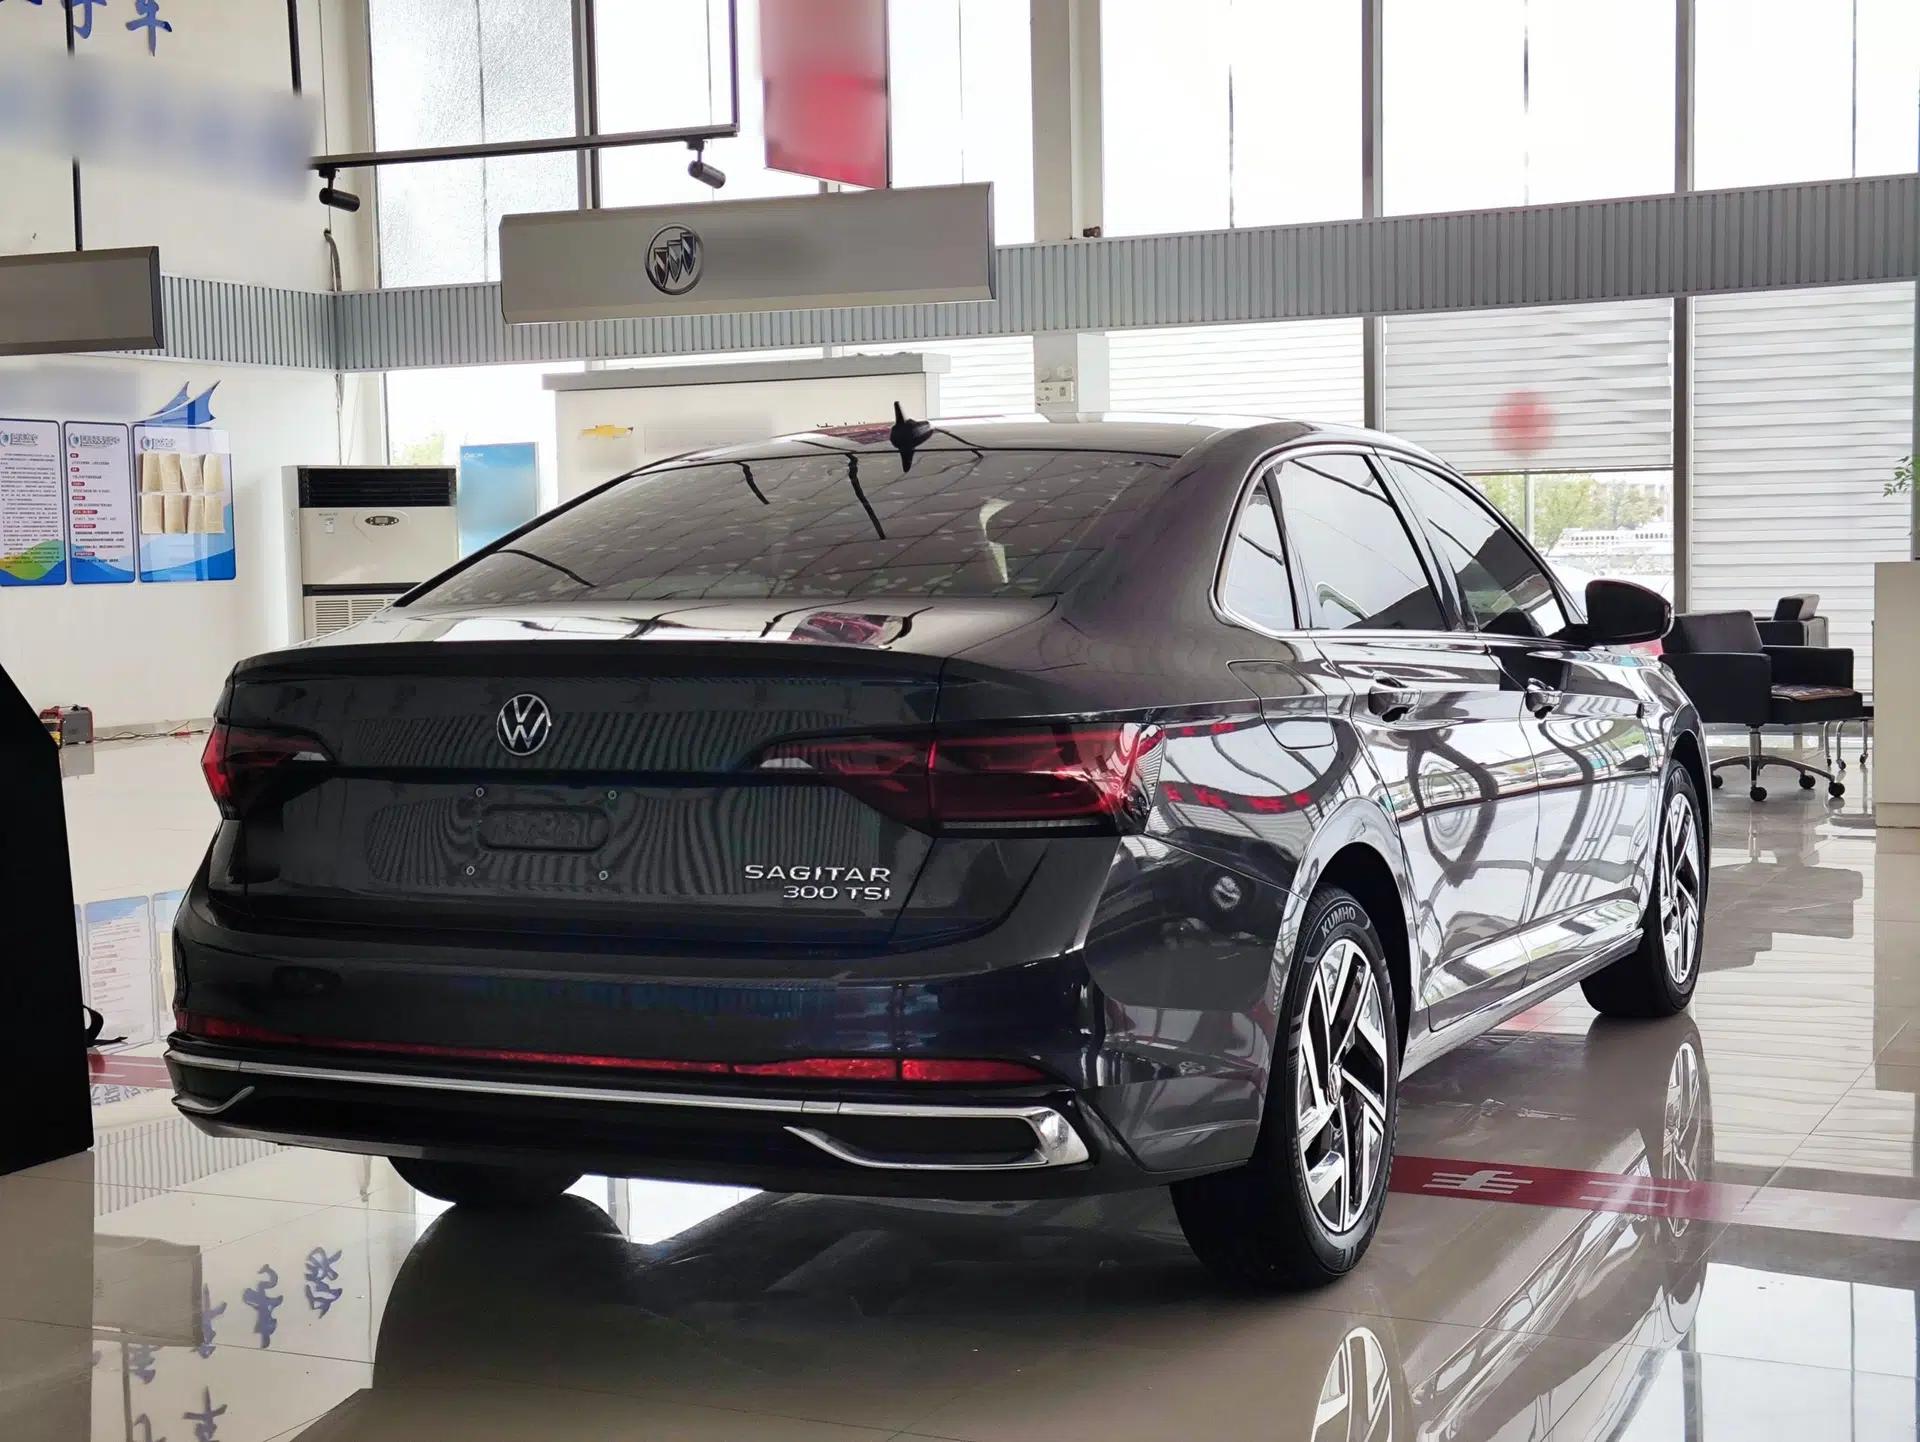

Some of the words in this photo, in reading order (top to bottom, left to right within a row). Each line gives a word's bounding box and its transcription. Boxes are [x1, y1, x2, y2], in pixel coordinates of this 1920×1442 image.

[497, 694, 551, 756] VW
[745, 865, 891, 882] SAGITAR
[783, 885, 838, 899] 300
[846, 887, 890, 900] TSI
[1321, 906, 1356, 938] KUMHO
